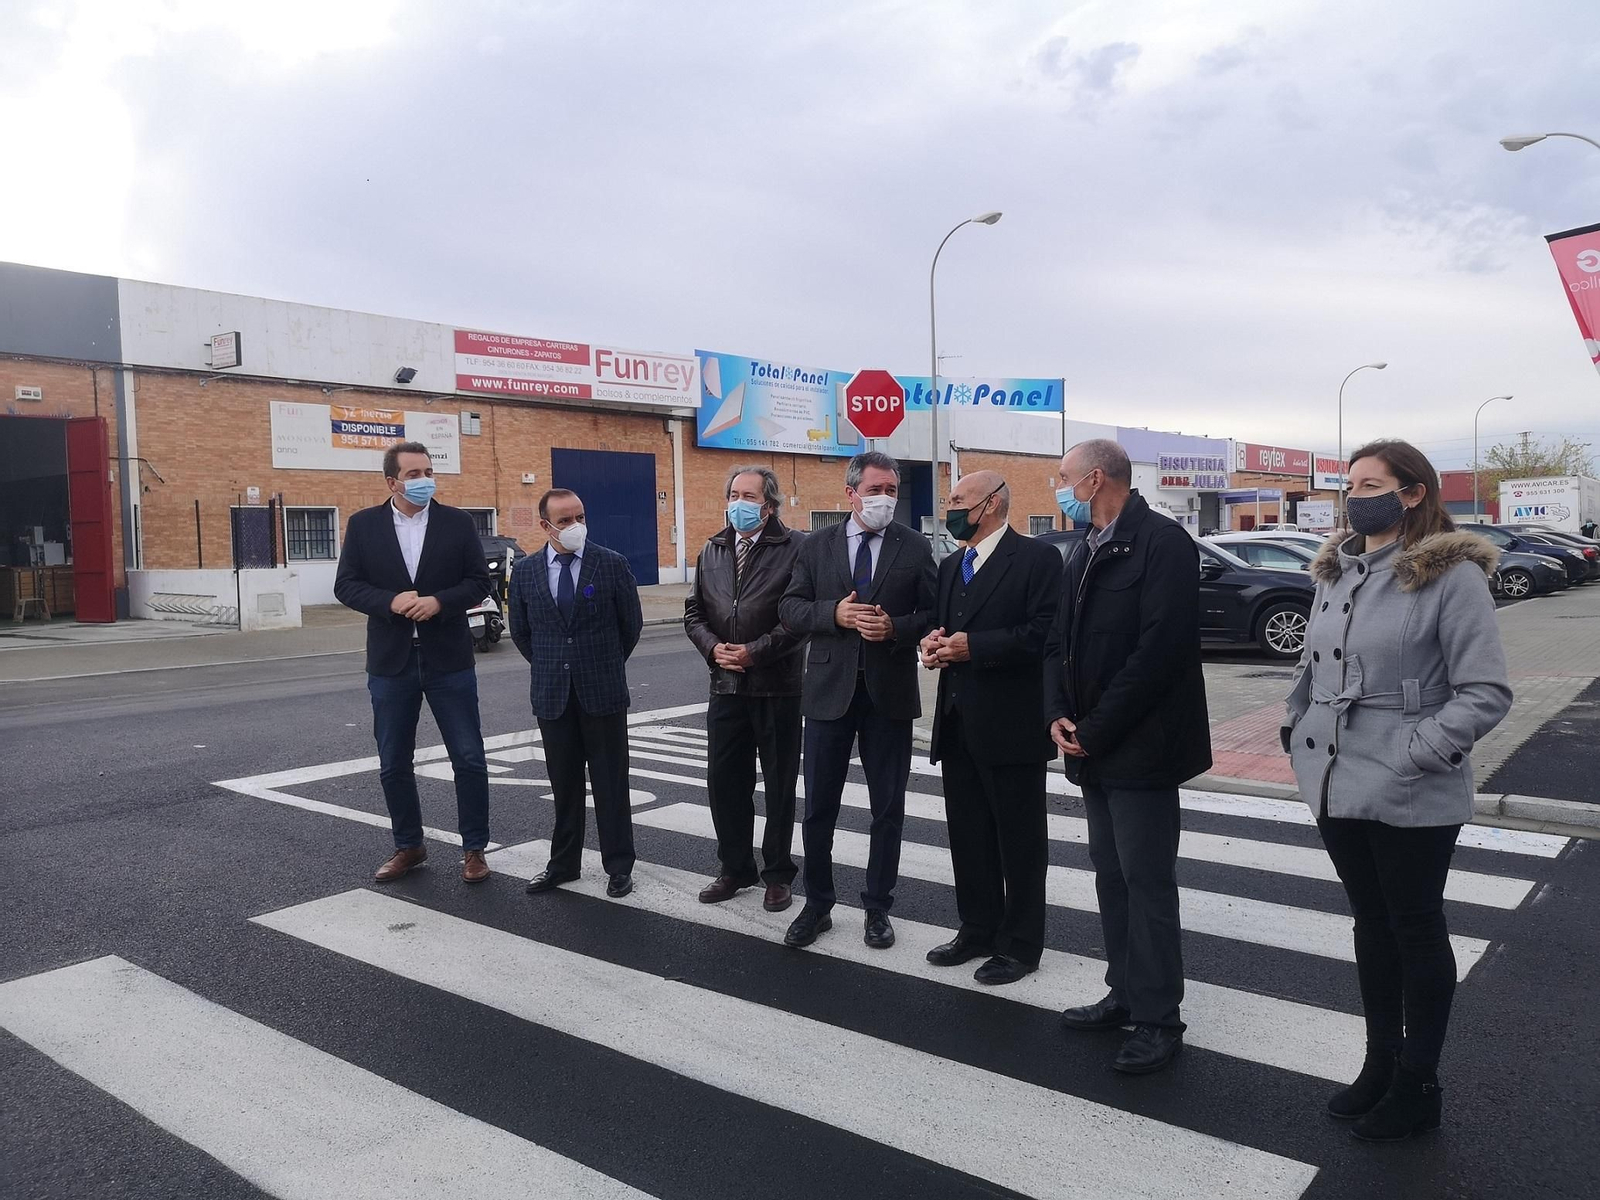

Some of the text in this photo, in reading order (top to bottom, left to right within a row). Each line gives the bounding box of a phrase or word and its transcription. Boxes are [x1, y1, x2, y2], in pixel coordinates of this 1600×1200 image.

[468, 333, 499, 343] REGALOS
[500, 336, 510, 344] DE
[511, 338, 541, 347] EMPRESA
[545, 341, 578, 352] CARTERAS
[487, 346, 529, 356] CINTURONES
[533, 350, 561, 359] ZAPATOS
[595, 349, 695, 392] Funrey
[751, 361, 829, 386] Total Panel
[471, 378, 579, 395] www.funrey.com
[972, 383, 1053, 406] Panel
[597, 388, 693, 404] bolsos & complementos
[851, 395, 901, 412] STOP
[341, 422, 397, 435] DISPONIBLE
[341, 434, 359, 445] 954
[361, 436, 378, 446] 571
[1161, 456, 1225, 471] BISUTERIA
[1259, 447, 1286, 472] reytex
[1192, 474, 1226, 488] JULIA
[1511, 480, 1569, 488] WWW.AVICAR.ES
